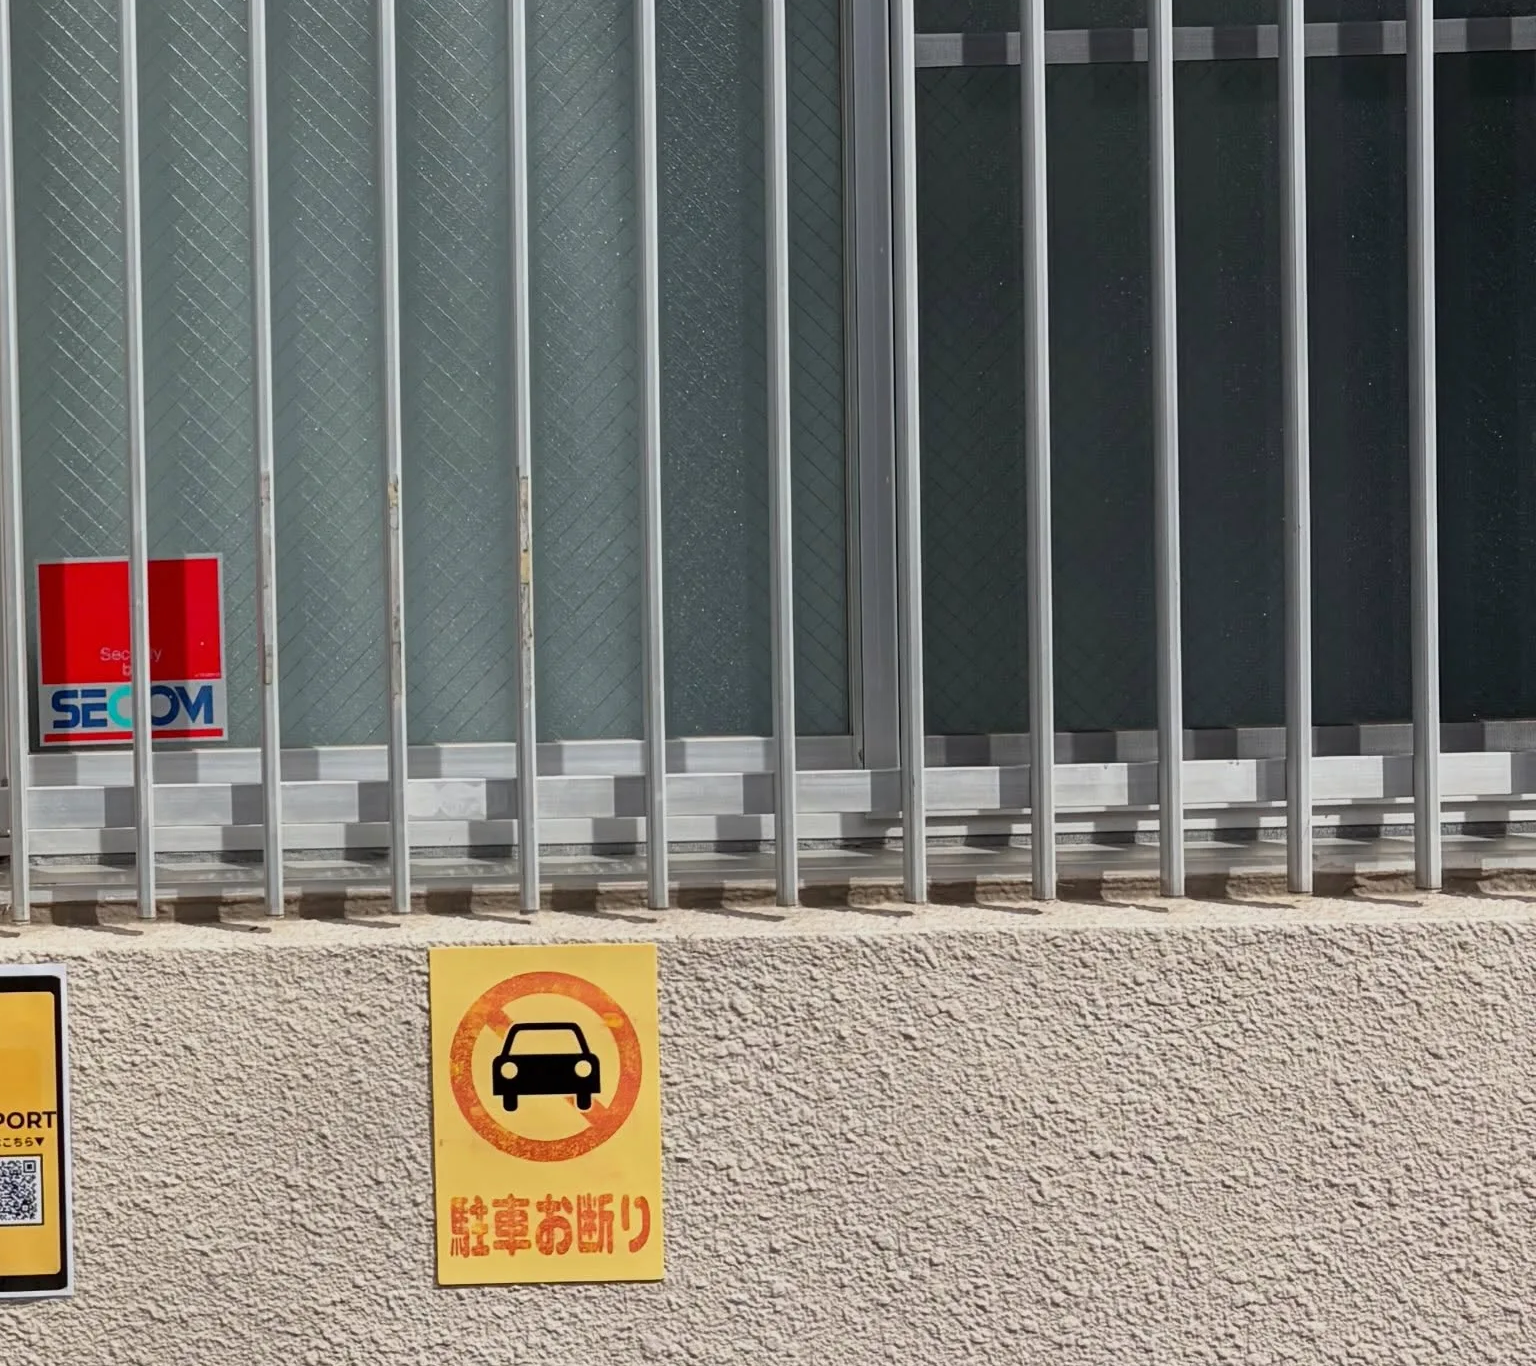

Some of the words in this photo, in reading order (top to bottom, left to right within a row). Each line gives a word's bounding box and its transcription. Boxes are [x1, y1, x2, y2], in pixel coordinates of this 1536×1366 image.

[449, 1193, 652, 1258] 駐車お断り
